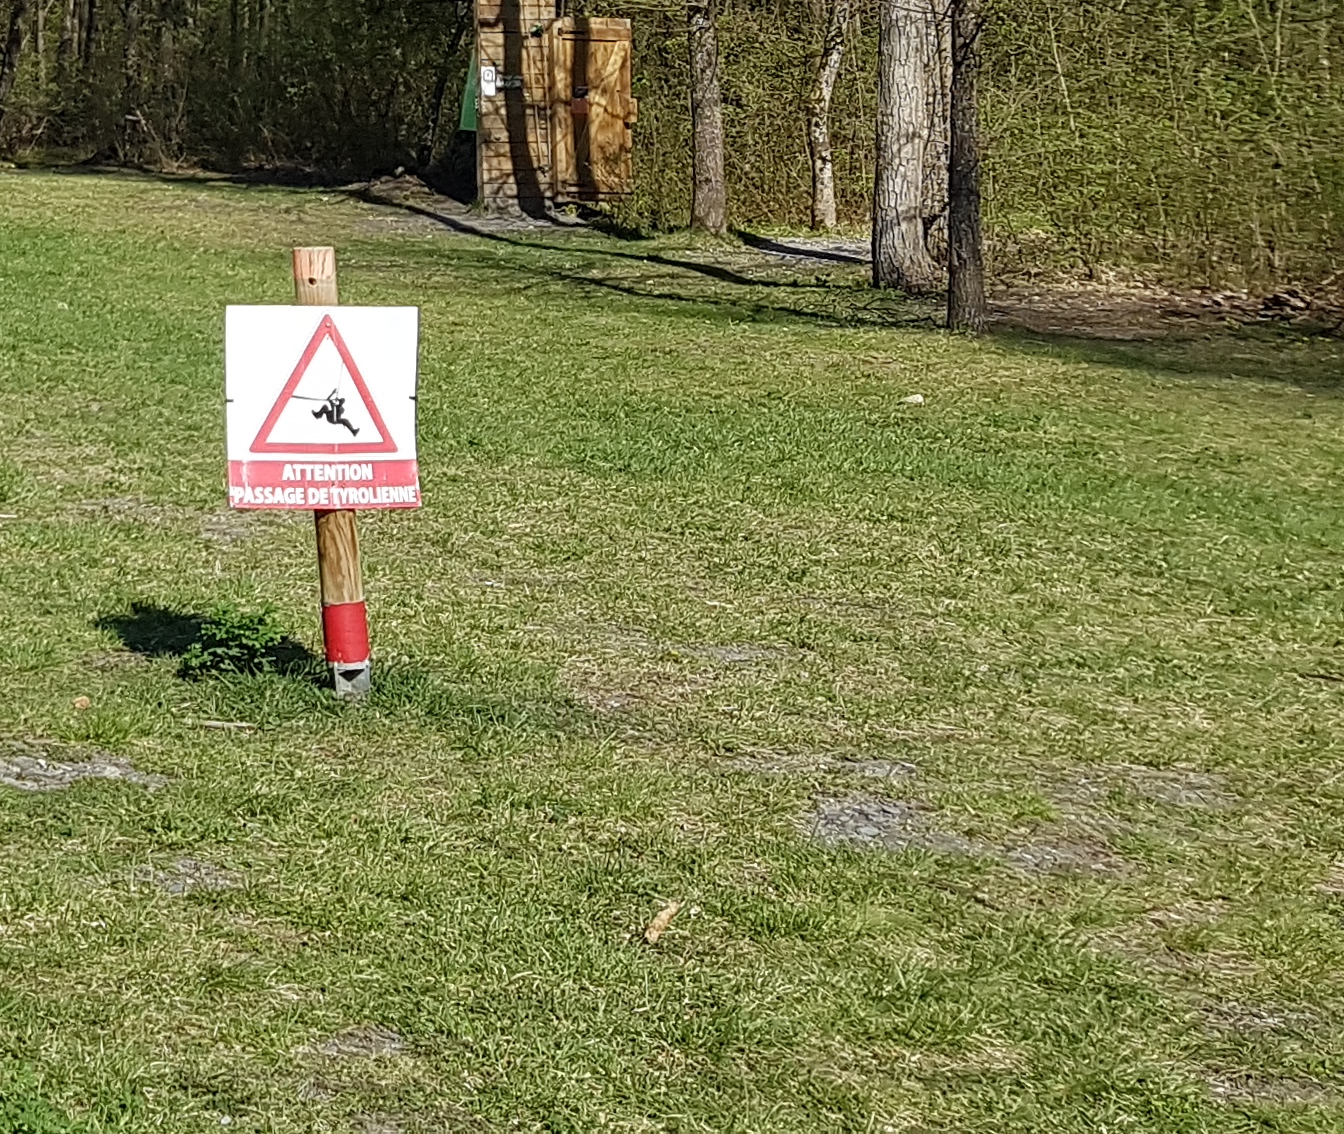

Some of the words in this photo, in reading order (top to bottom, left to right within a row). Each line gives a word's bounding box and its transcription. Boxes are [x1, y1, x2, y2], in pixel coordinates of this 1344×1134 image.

[281, 463, 374, 481] ATTENTION
[233, 485, 306, 505] PASSAGE
[308, 486, 329, 505] DE
[330, 485, 418, 504] TYROLIENNE
